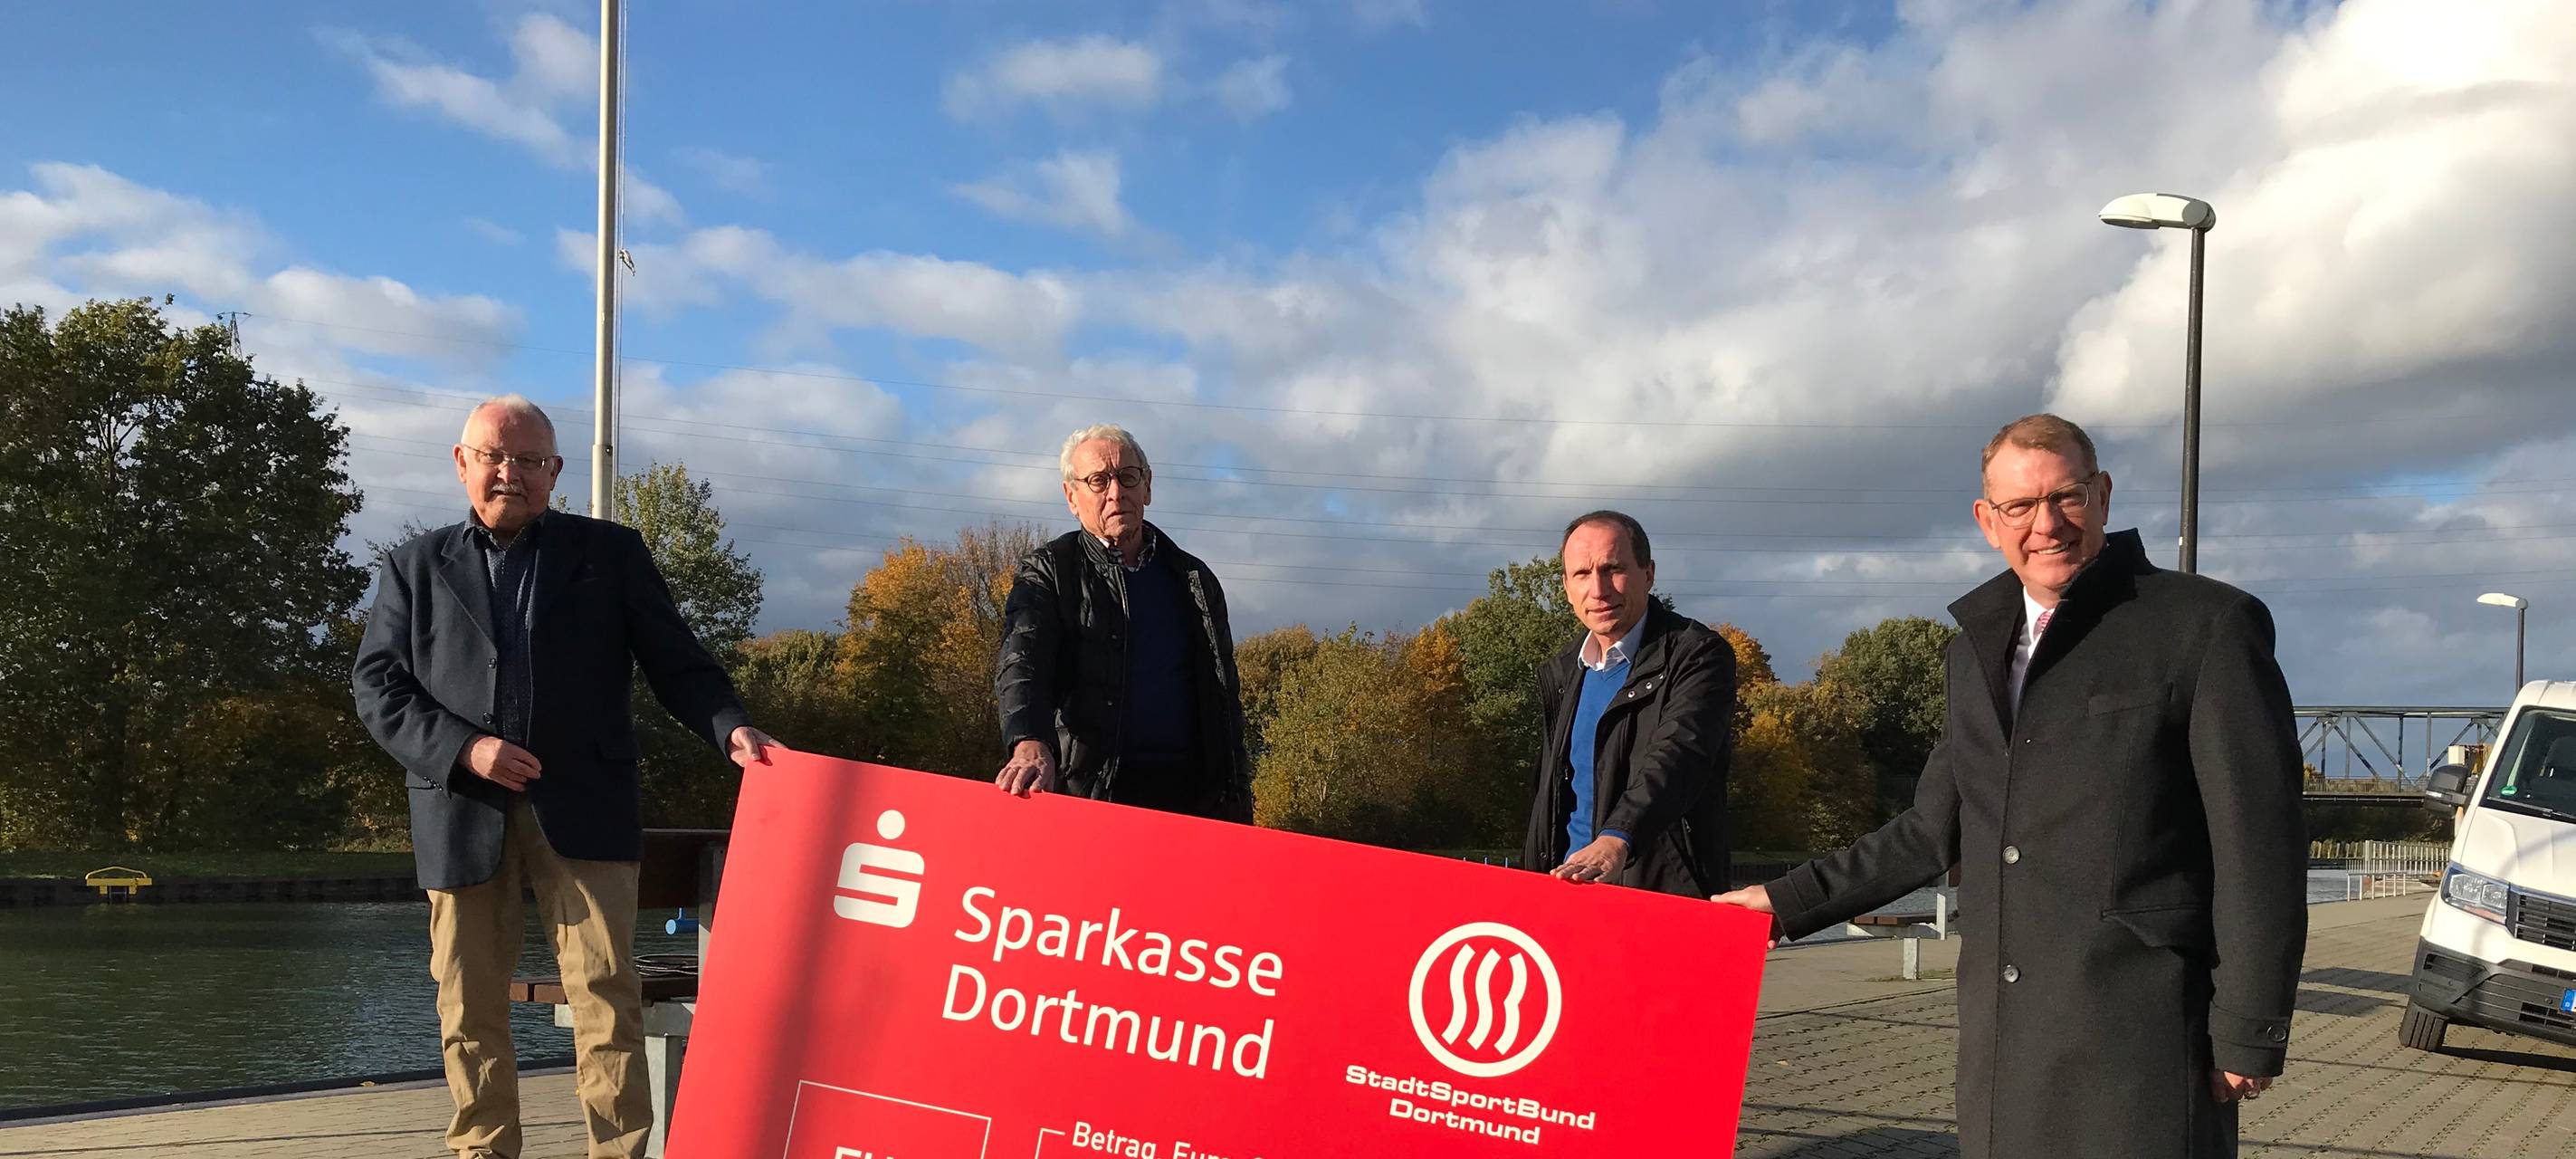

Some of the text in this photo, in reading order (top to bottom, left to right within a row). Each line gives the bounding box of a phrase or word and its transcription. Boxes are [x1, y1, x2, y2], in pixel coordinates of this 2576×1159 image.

[954, 886, 1283, 997] Sparkasse
[941, 963, 1275, 1079] Dortmund
[1345, 1065, 1596, 1131] StadtSportBund
[1389, 1097, 1541, 1145] Dortmund
